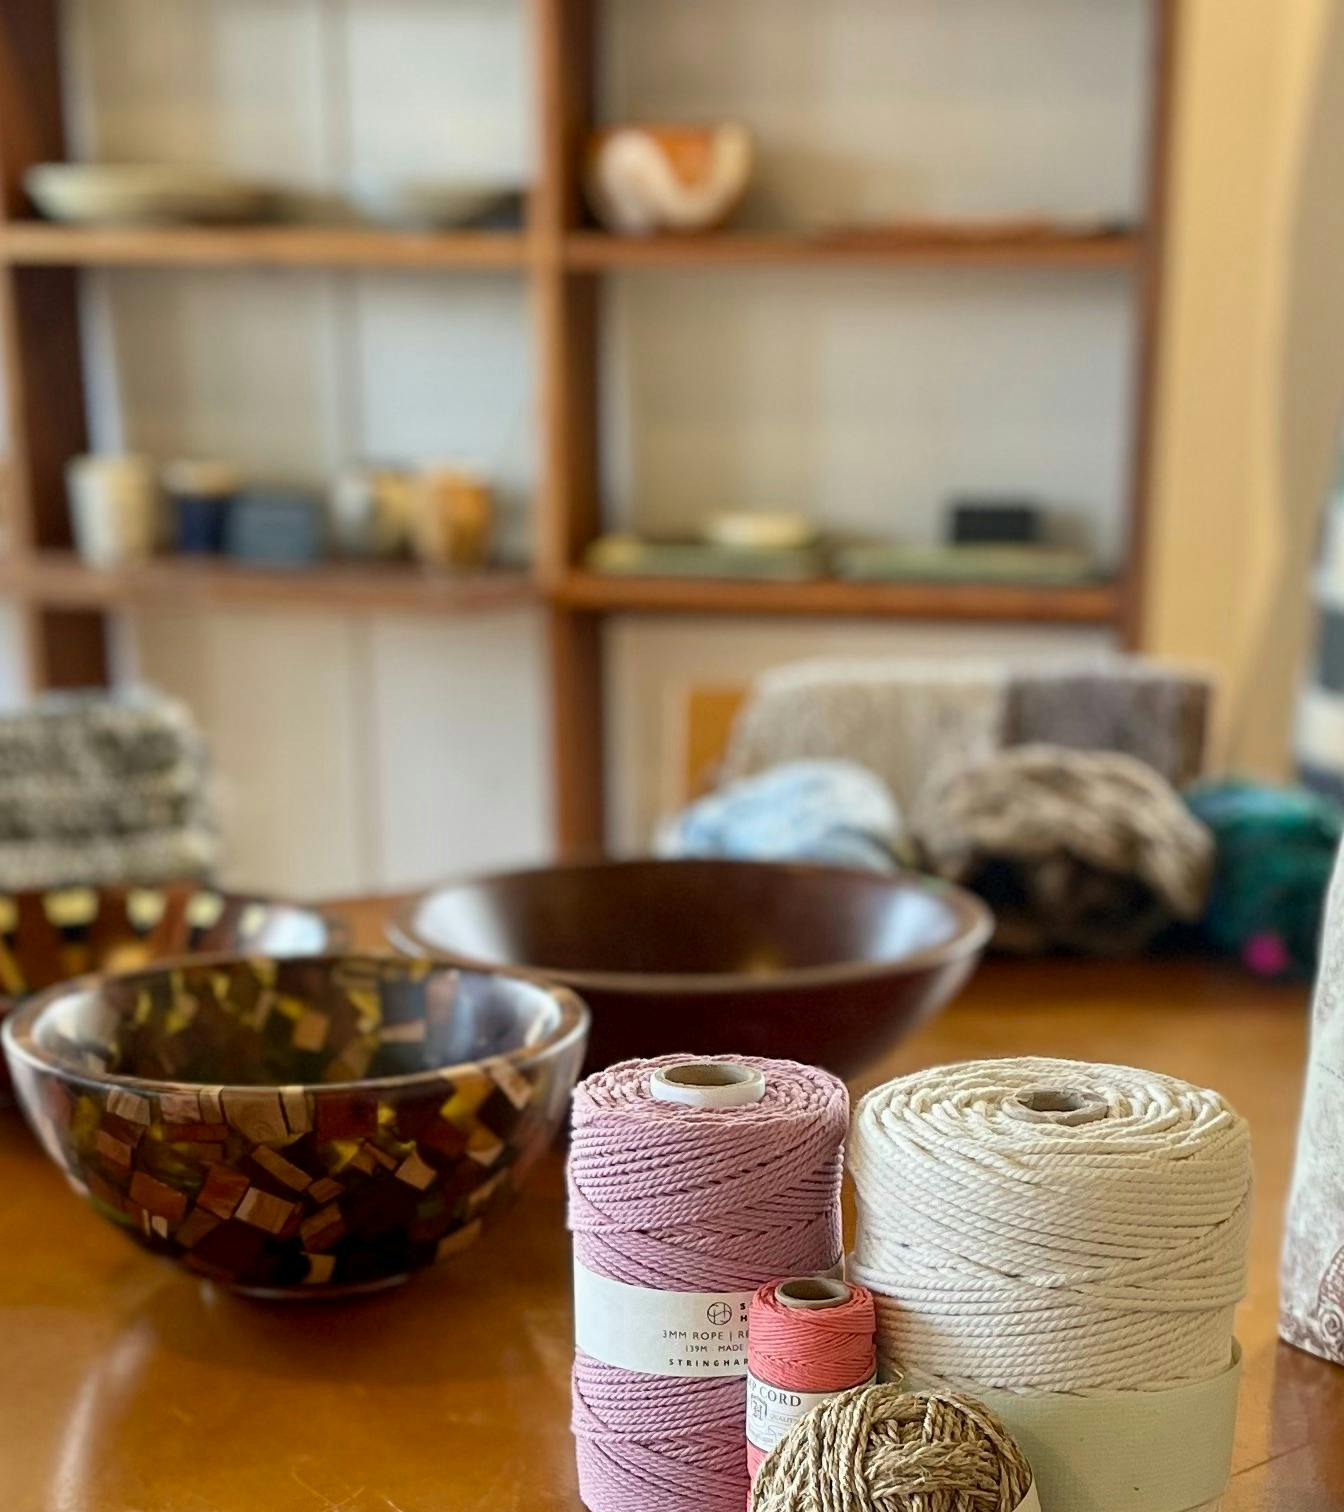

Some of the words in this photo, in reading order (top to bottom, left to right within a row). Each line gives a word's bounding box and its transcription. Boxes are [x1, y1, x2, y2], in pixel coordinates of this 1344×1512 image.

[662, 1330, 687, 1339] 3MM
[692, 1331, 724, 1340] ROPE
[718, 1344, 744, 1352] MADE
[759, 1386, 802, 1407] CORD
